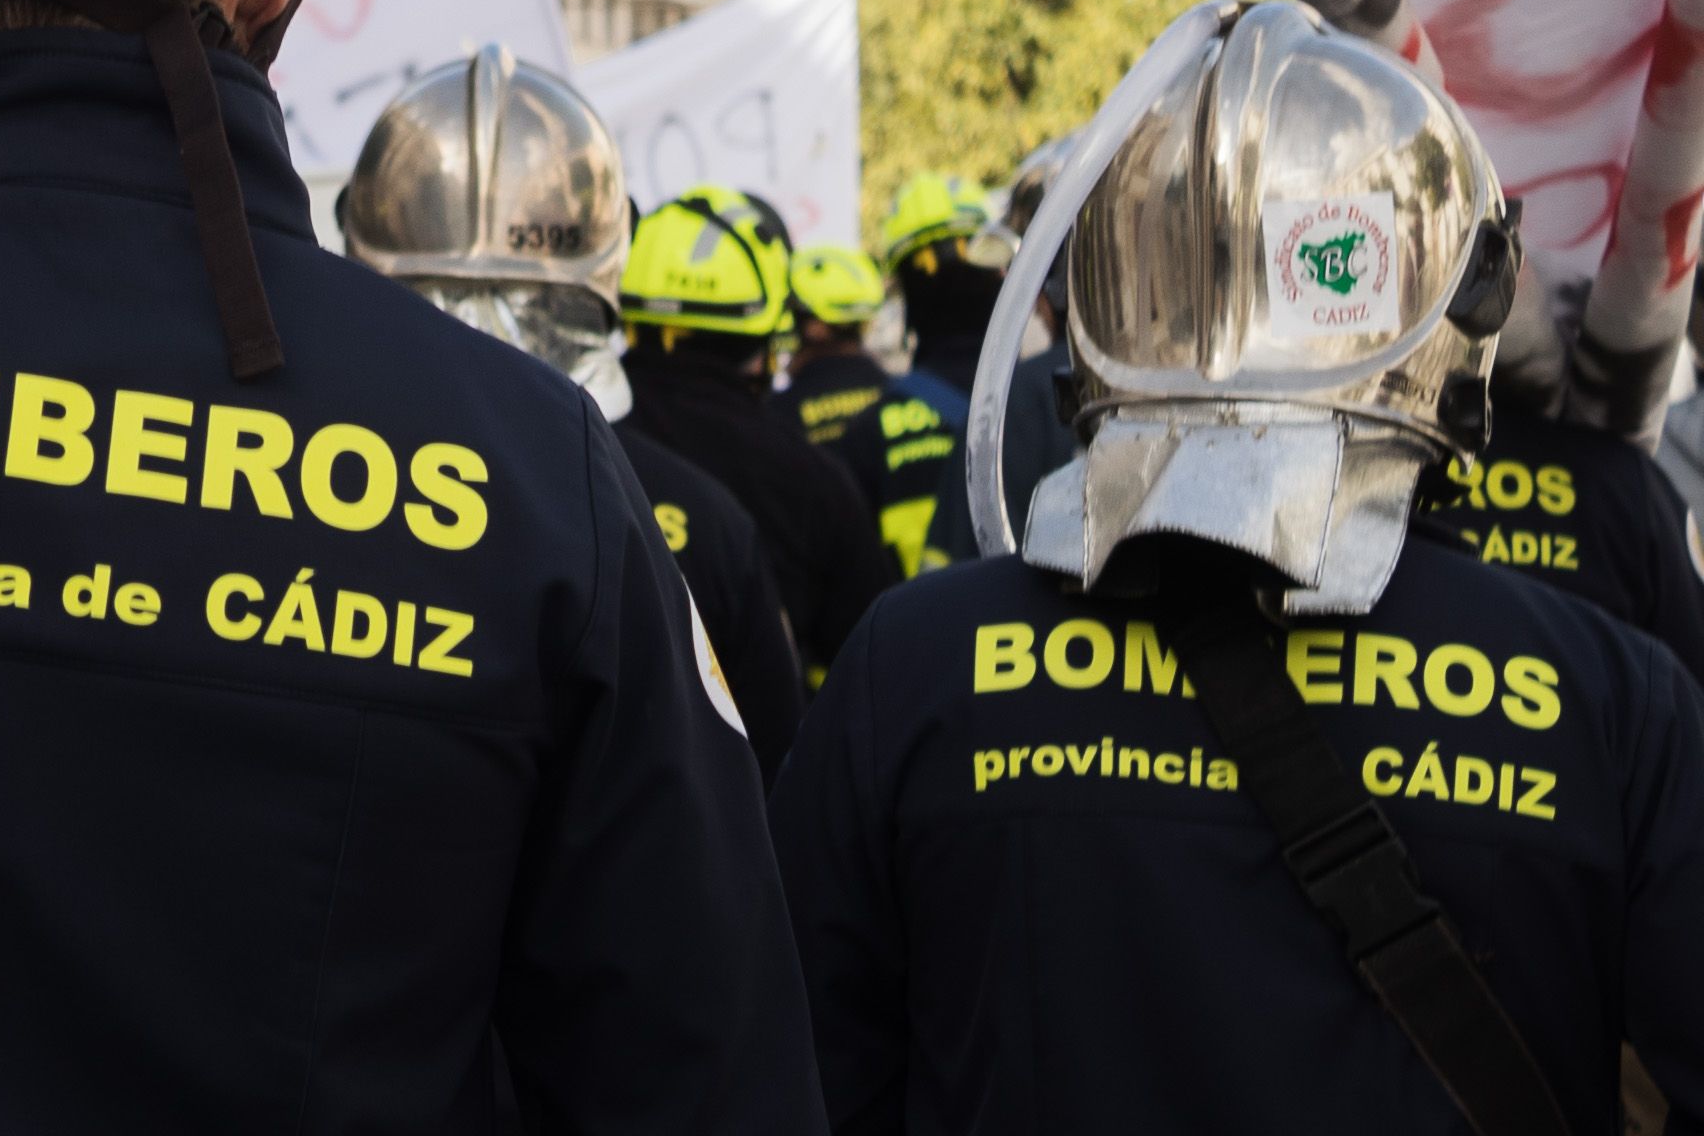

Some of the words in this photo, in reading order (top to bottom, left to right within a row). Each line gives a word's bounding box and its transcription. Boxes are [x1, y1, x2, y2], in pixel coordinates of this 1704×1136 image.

[1317, 202, 1342, 223] de
[61, 563, 162, 627] de
[205, 568, 475, 678] CÁDIZ
[973, 617, 1562, 731] BOMEROS
[973, 736, 1239, 792] provincia
[1361, 740, 1558, 821] CÁDIZ
